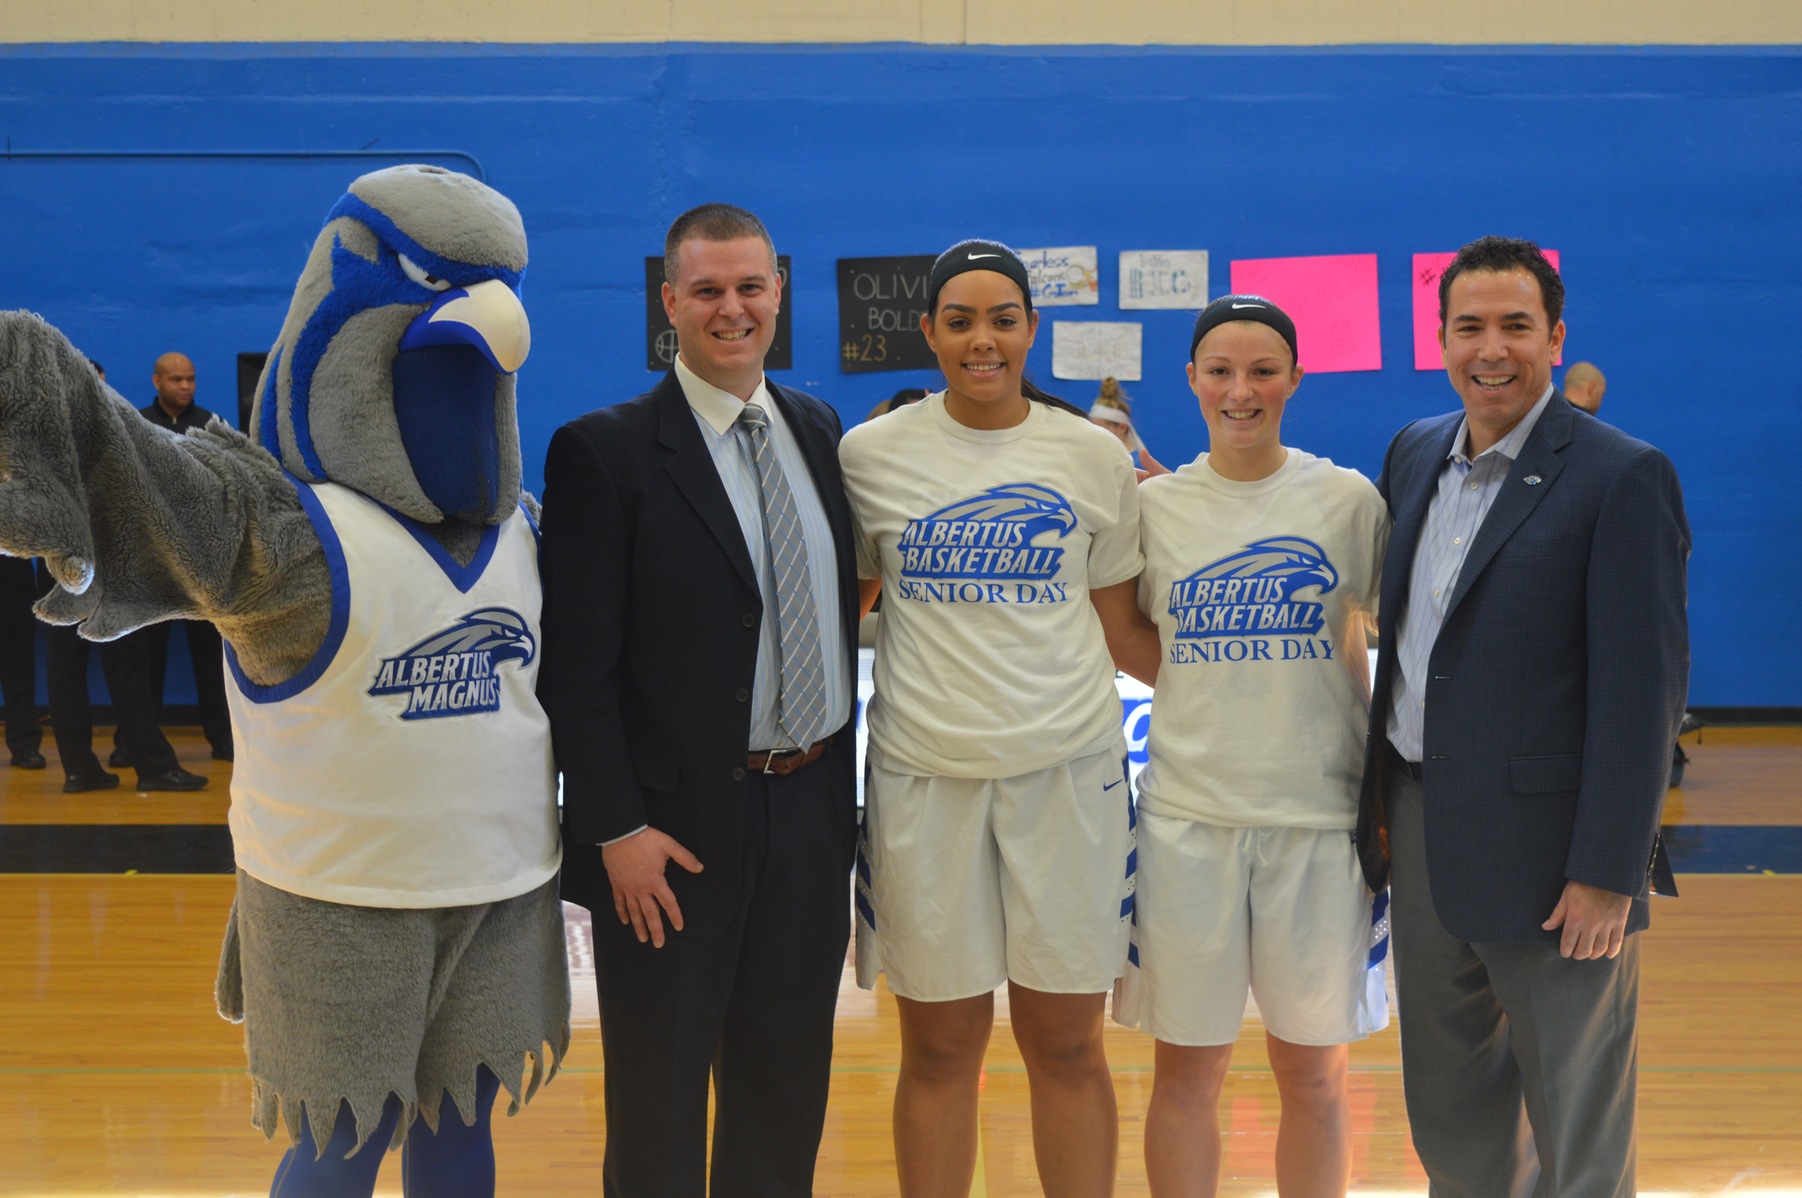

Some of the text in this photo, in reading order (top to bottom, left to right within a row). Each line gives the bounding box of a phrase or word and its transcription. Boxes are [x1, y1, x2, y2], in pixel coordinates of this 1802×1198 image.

[853, 273, 928, 300] OLIVI
[868, 307, 922, 332] BOLD
[842, 333, 888, 362] #23
[902, 521, 1027, 548] ALBERTUS
[904, 547, 1058, 575] BASKETBALL
[899, 579, 1068, 604] SENIOR DAY
[1171, 577, 1288, 609] ALBERTUS
[1176, 603, 1317, 634] BASKETBALL
[1170, 638, 1336, 664] SENIOR DAY
[375, 651, 492, 689] ALBERTUS
[407, 678, 498, 713] MAGNUS
